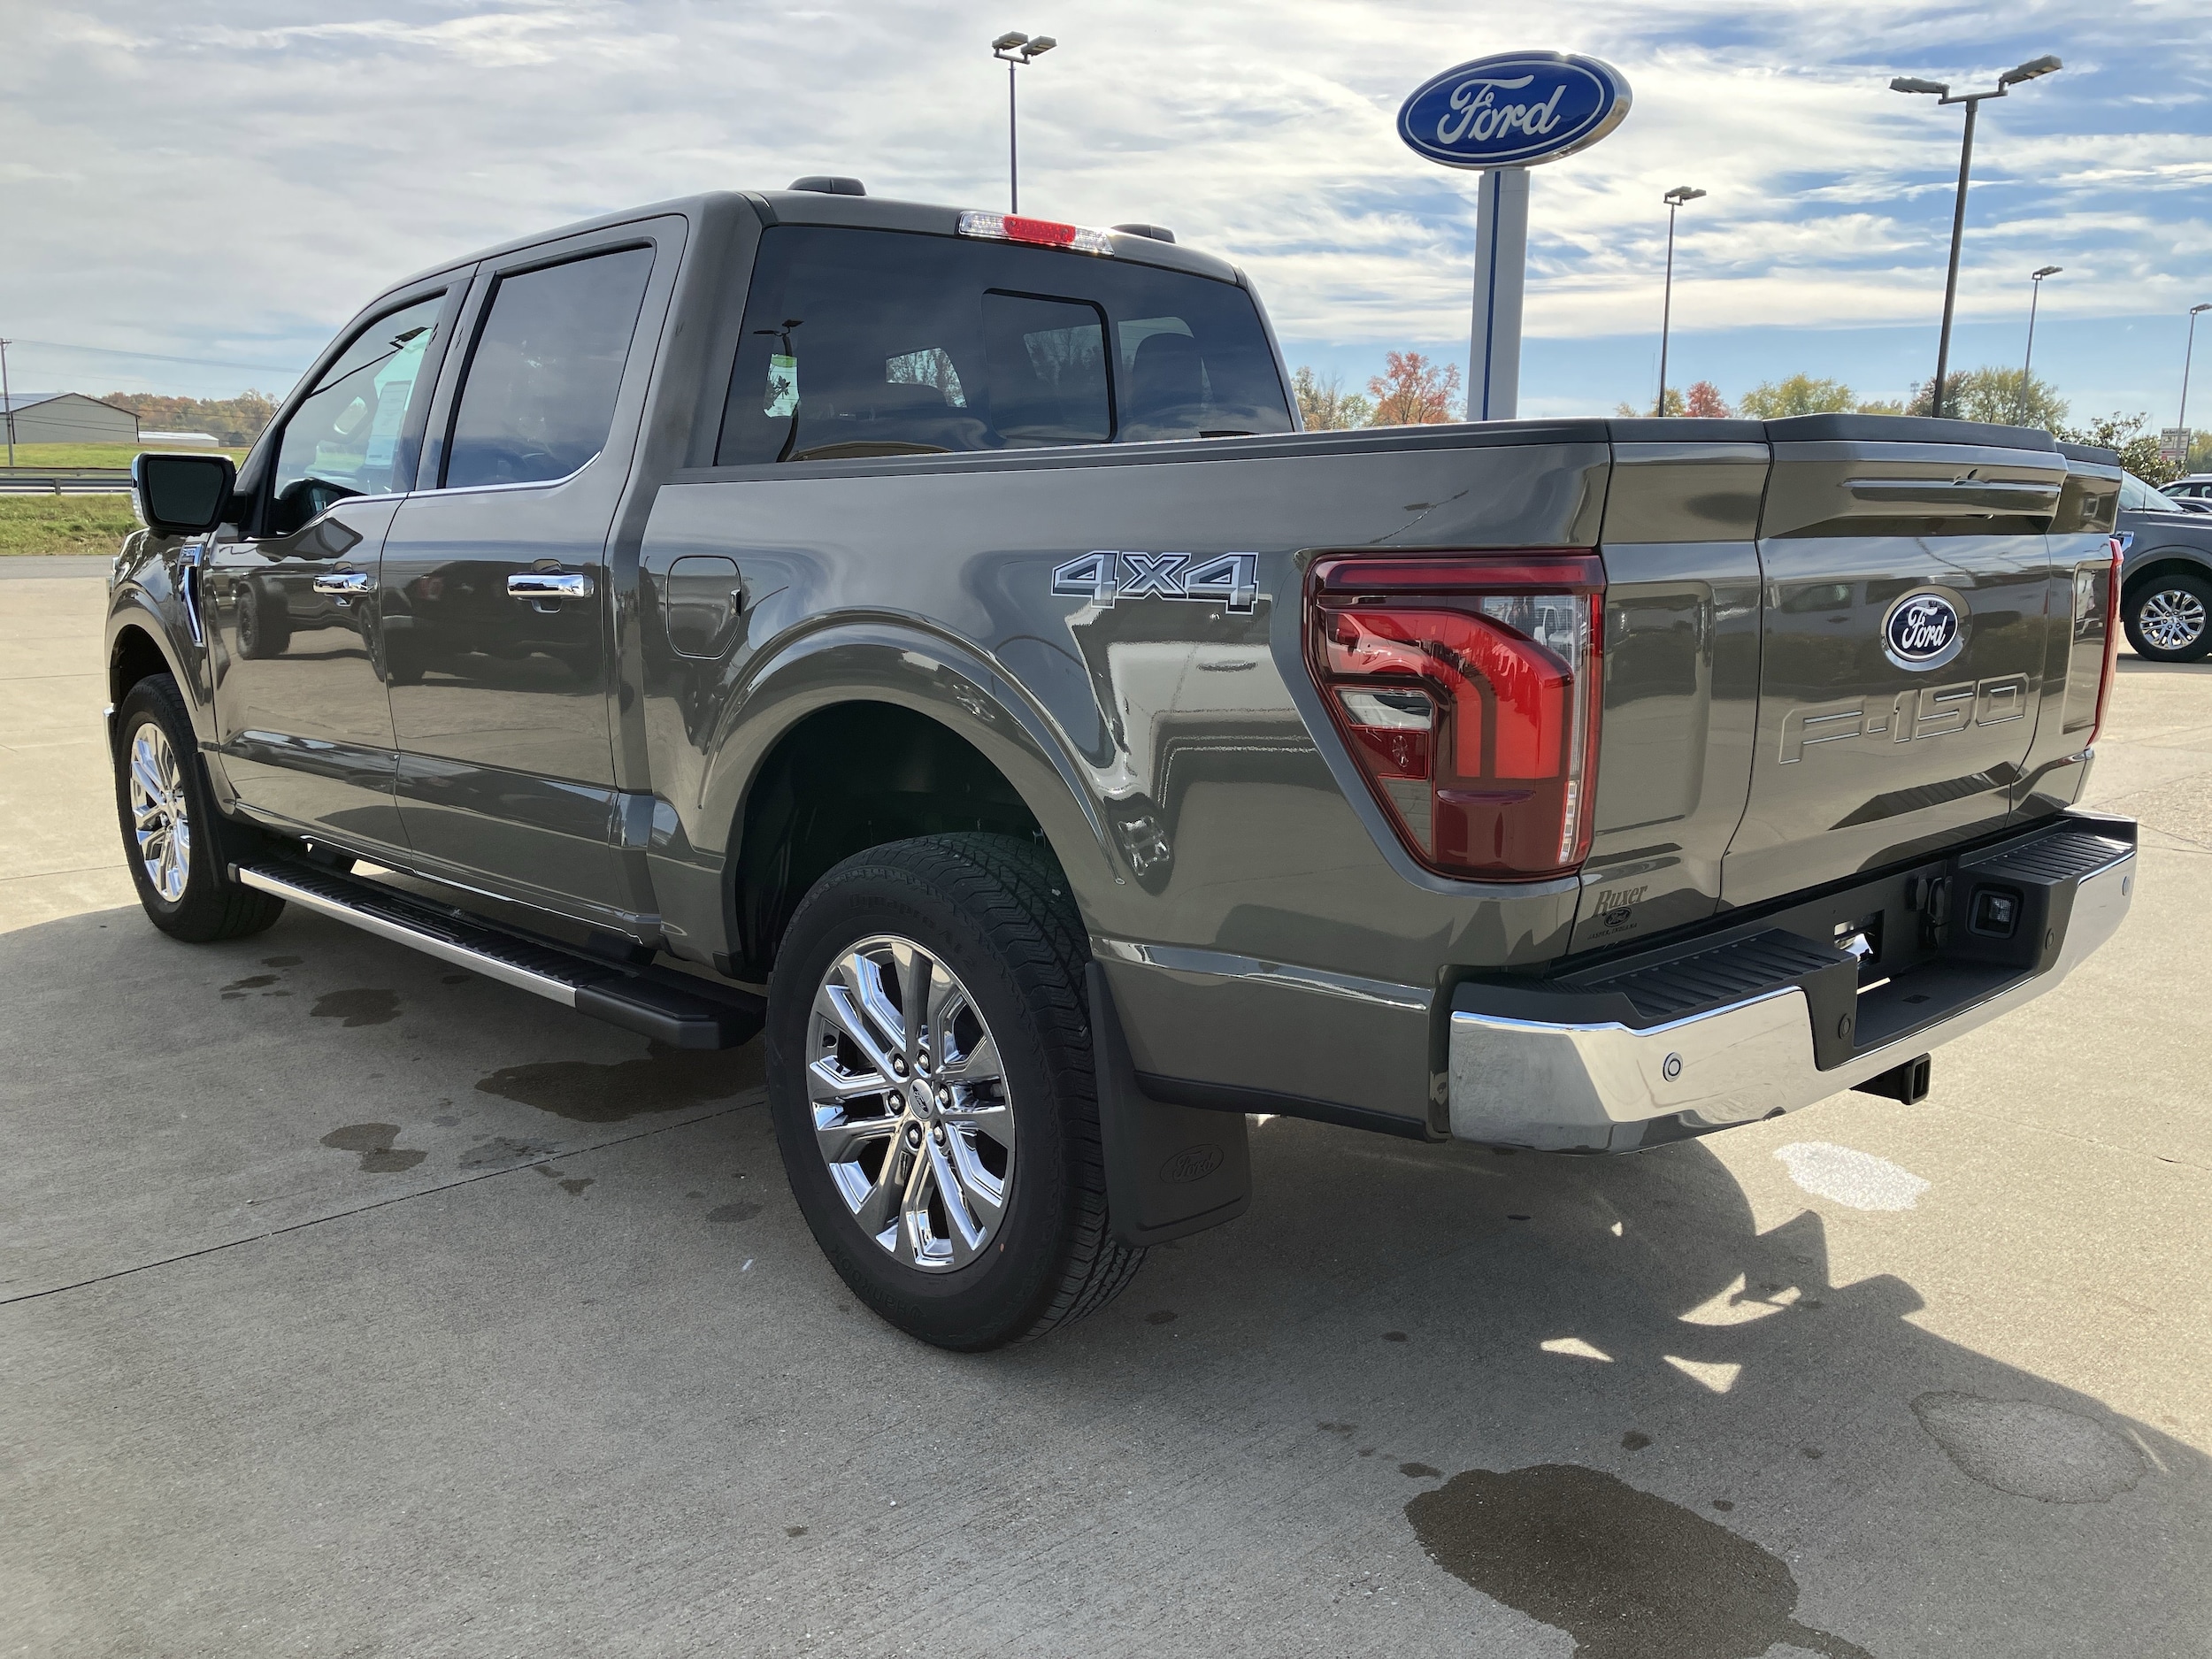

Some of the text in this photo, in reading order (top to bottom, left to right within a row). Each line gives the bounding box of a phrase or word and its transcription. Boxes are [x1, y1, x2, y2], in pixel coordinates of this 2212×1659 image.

[1437, 74, 1567, 144] Ford
[1901, 606, 1948, 649] Ford
[1778, 672, 2031, 765] F-150
[1592, 886, 1648, 918] Ruxer
[1171, 1149, 1215, 1182] Ford
